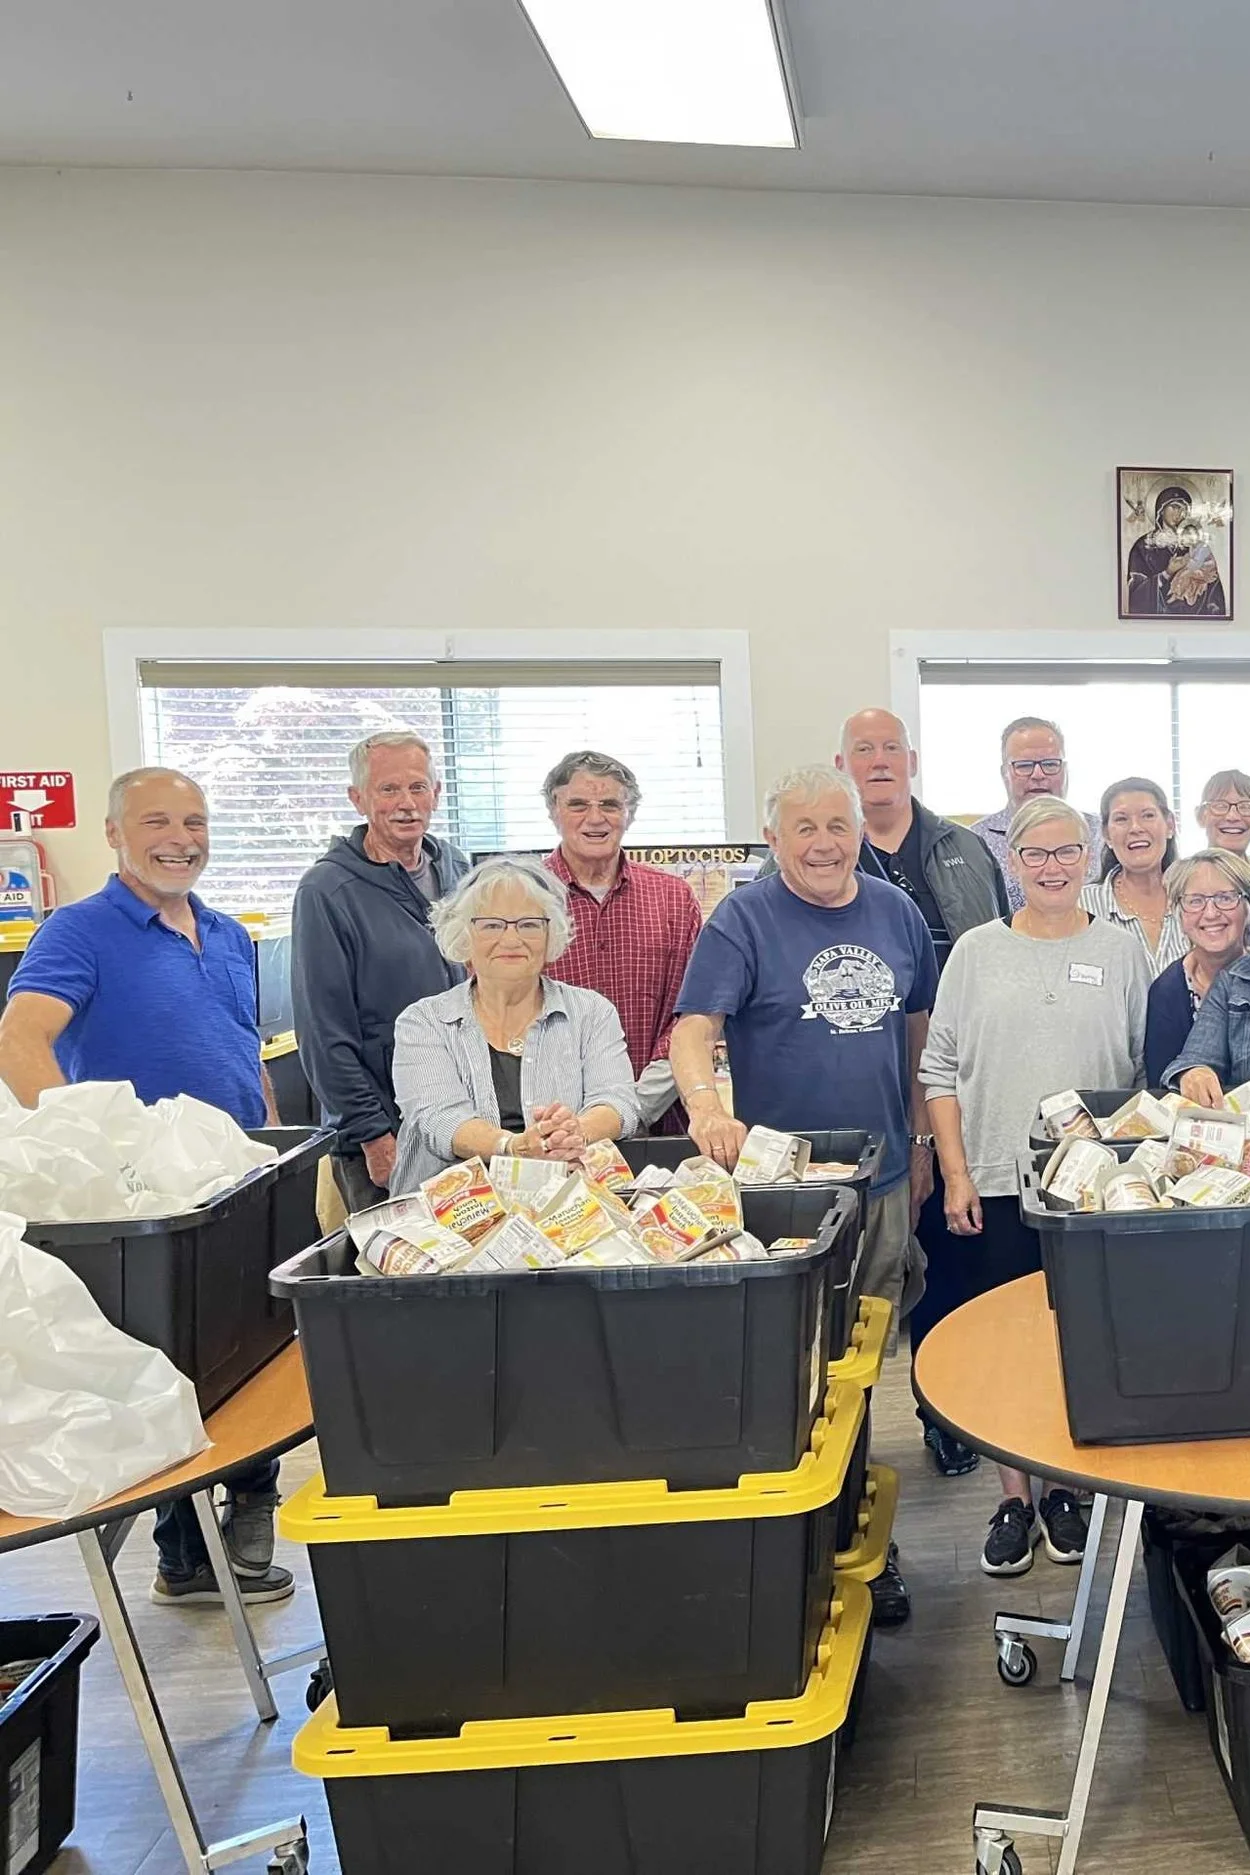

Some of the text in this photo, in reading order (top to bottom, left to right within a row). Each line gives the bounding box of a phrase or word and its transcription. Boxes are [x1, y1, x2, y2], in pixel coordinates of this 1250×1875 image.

[0, 775, 66, 787] IRST AID
[31, 814, 44, 826] IT
[813, 947, 881, 970] NAPA VALLEY
[814, 1001, 847, 1012] OLIVE
[850, 1000, 868, 1010] OIL
[549, 1199, 592, 1221] Maruchan
